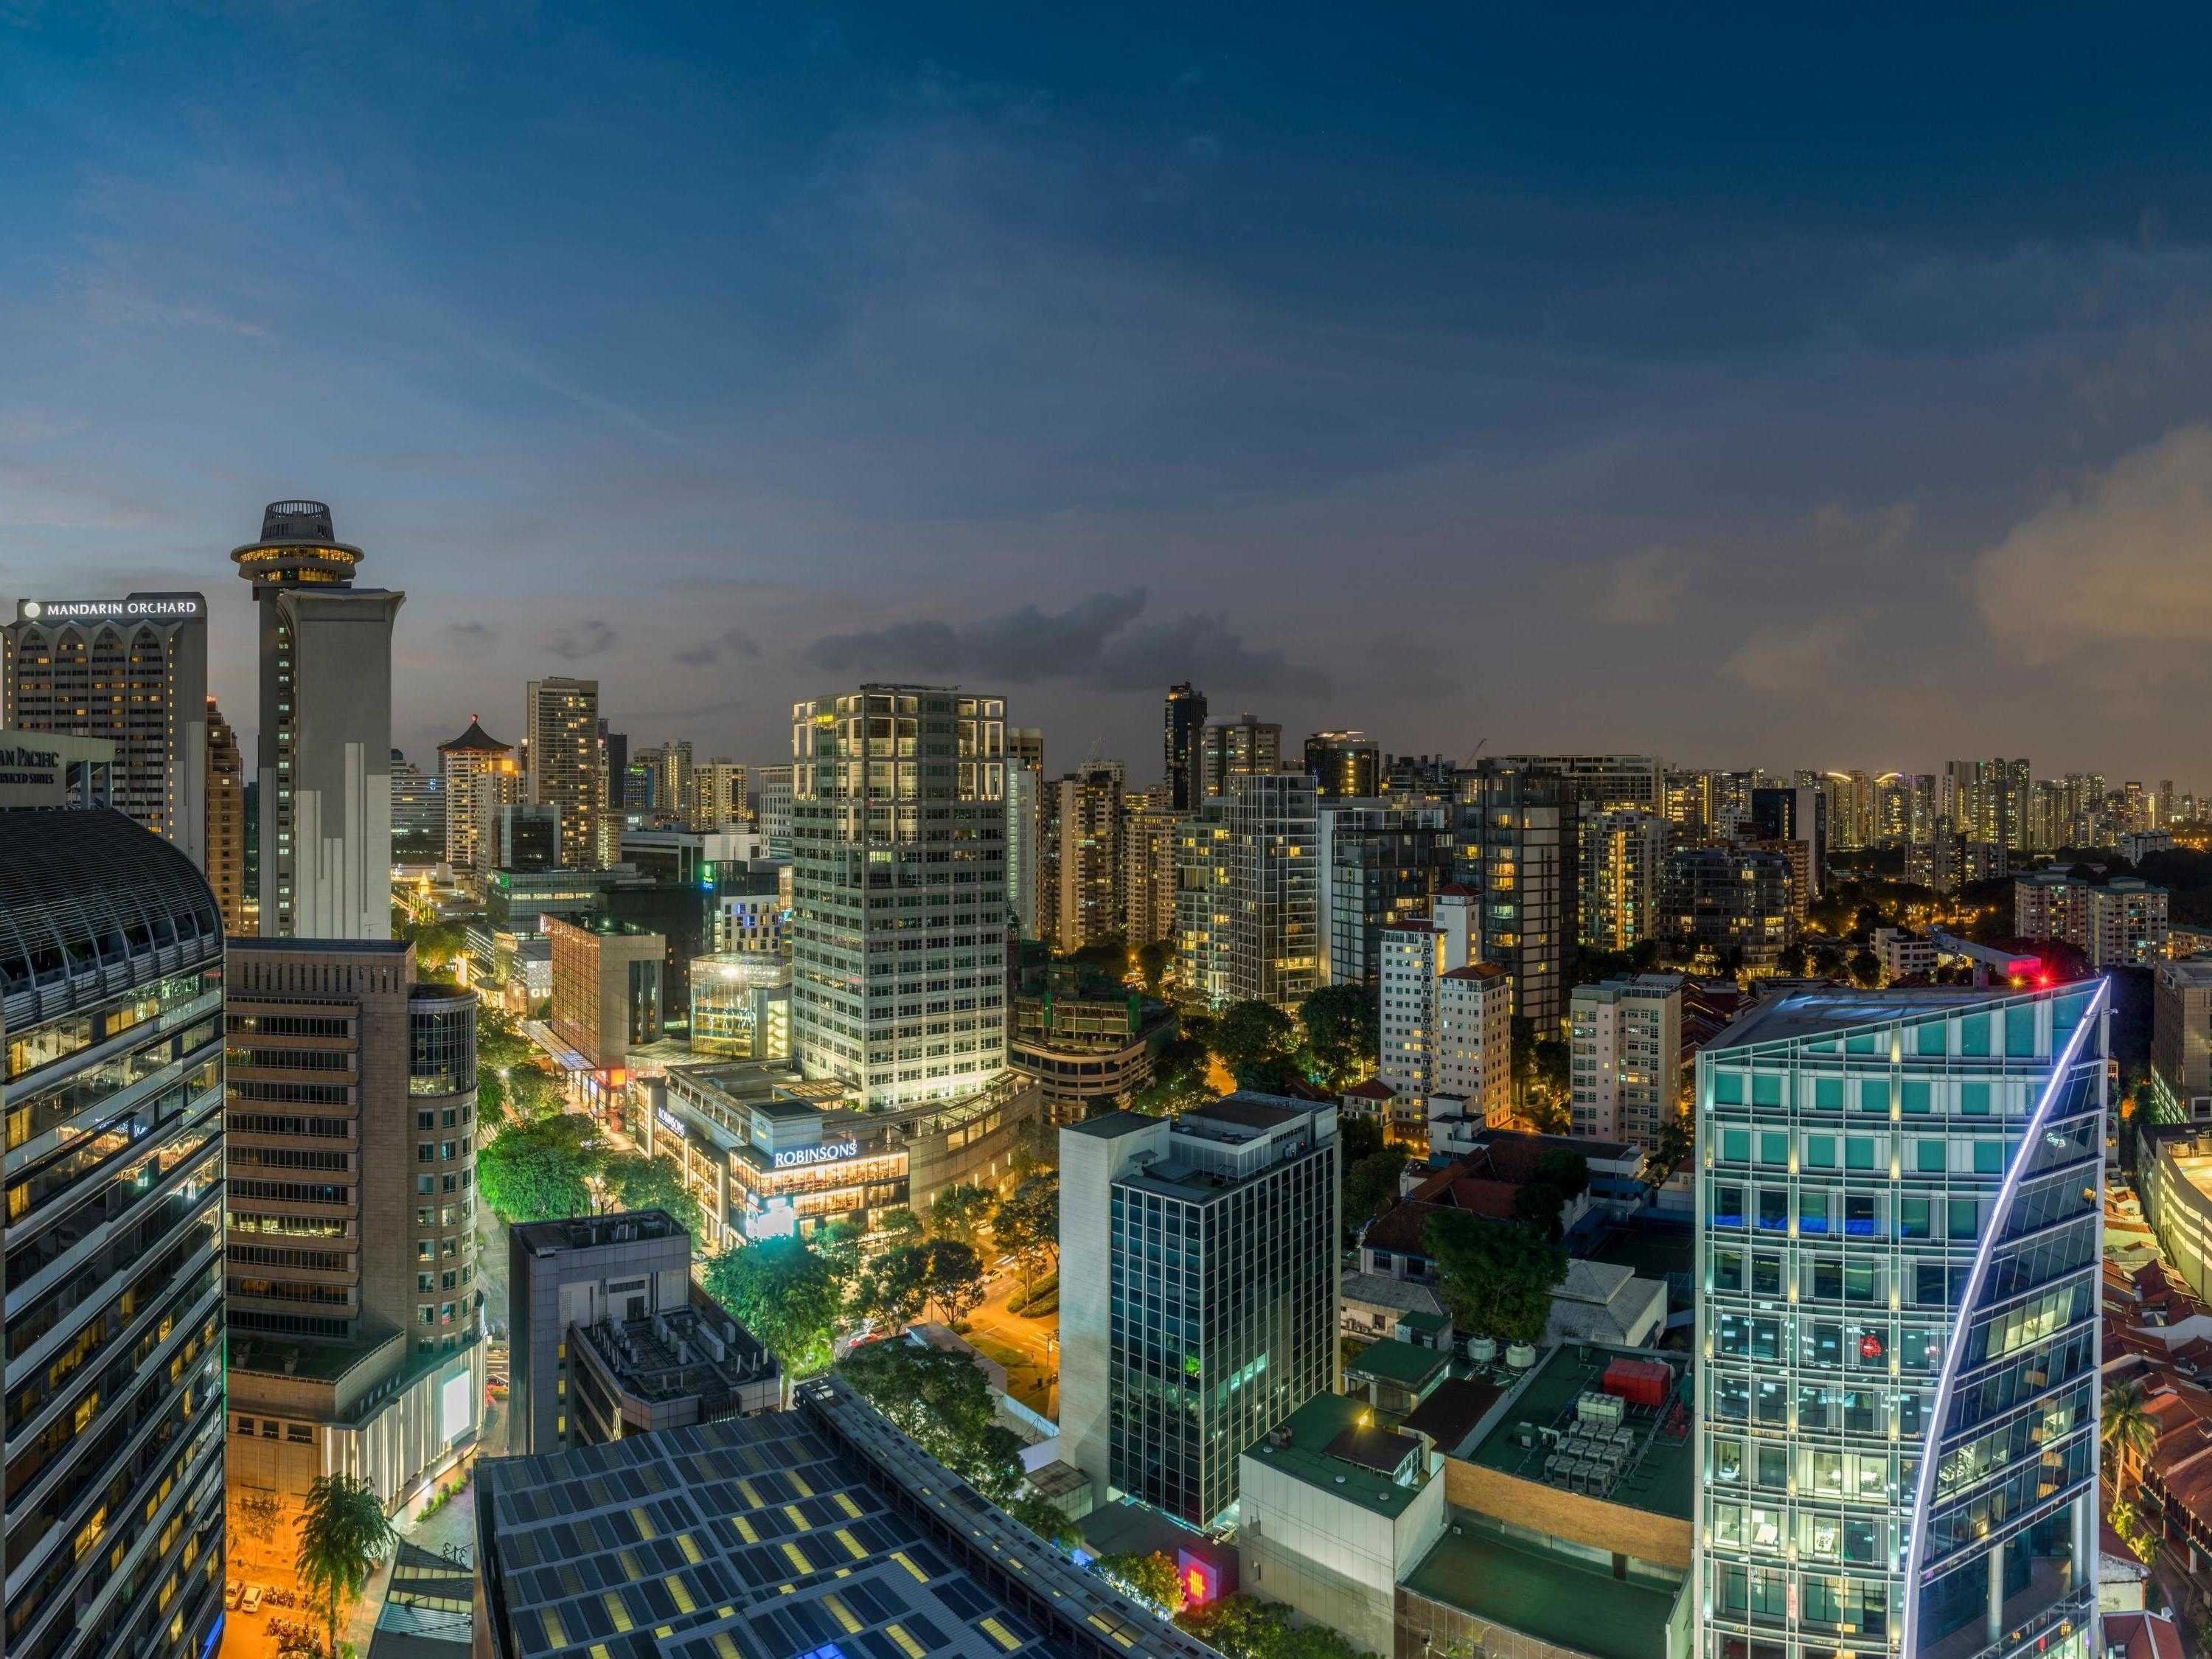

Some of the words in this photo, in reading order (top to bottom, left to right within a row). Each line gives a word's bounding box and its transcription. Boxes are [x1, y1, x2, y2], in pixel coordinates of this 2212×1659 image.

[47, 603, 122, 616] MANDARIN
[128, 602, 196, 613] ORCHARD
[775, 1142, 858, 1166] ROBINSONS
